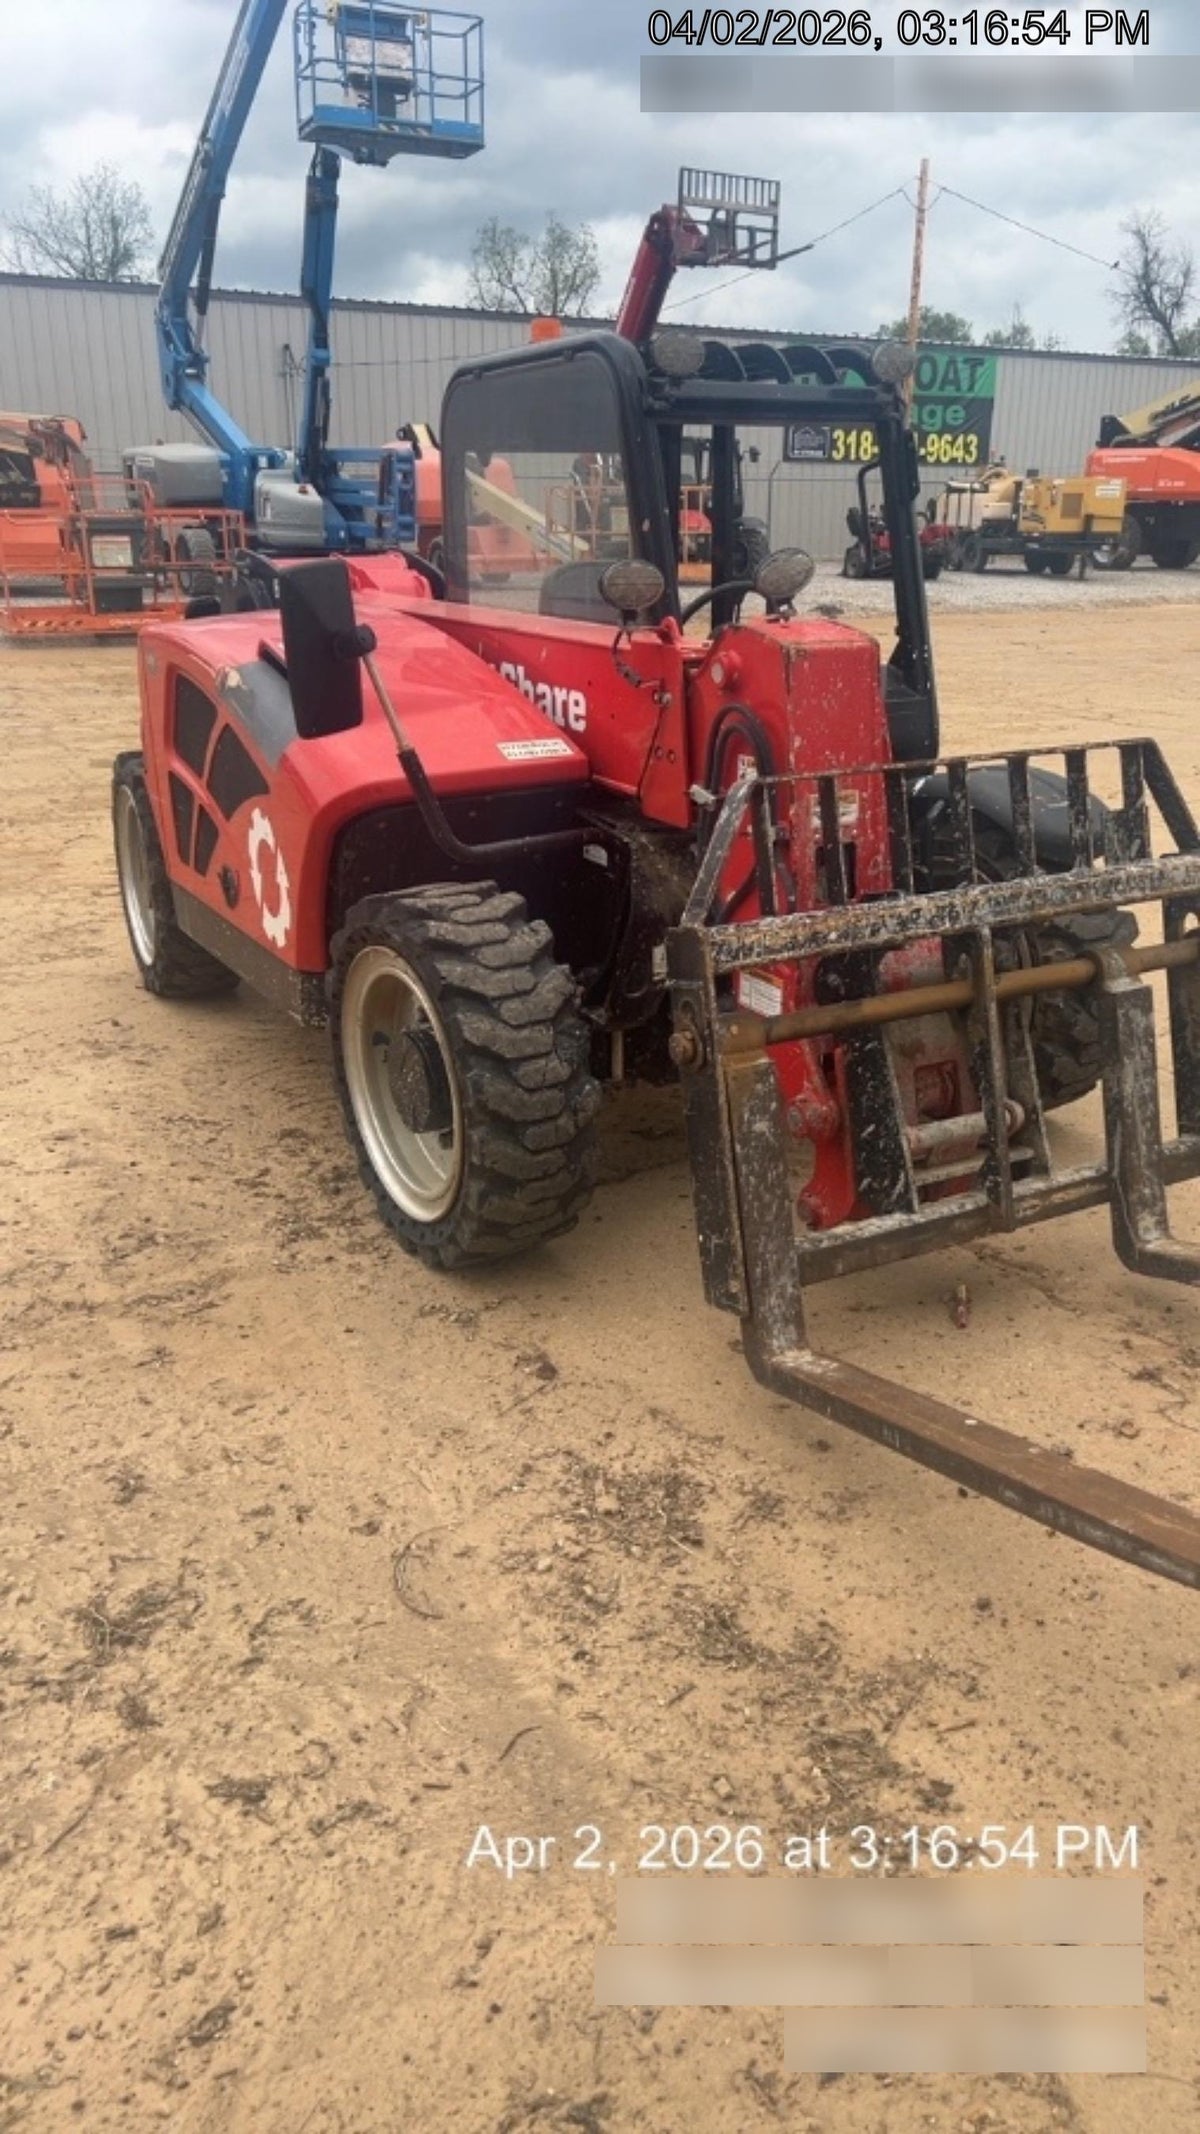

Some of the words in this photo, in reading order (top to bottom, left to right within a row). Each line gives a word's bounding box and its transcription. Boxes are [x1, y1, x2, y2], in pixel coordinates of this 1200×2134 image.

[915, 354, 984, 393] OAT
[832, 428, 978, 464] 318--9643
[489, 661, 587, 733] Share
